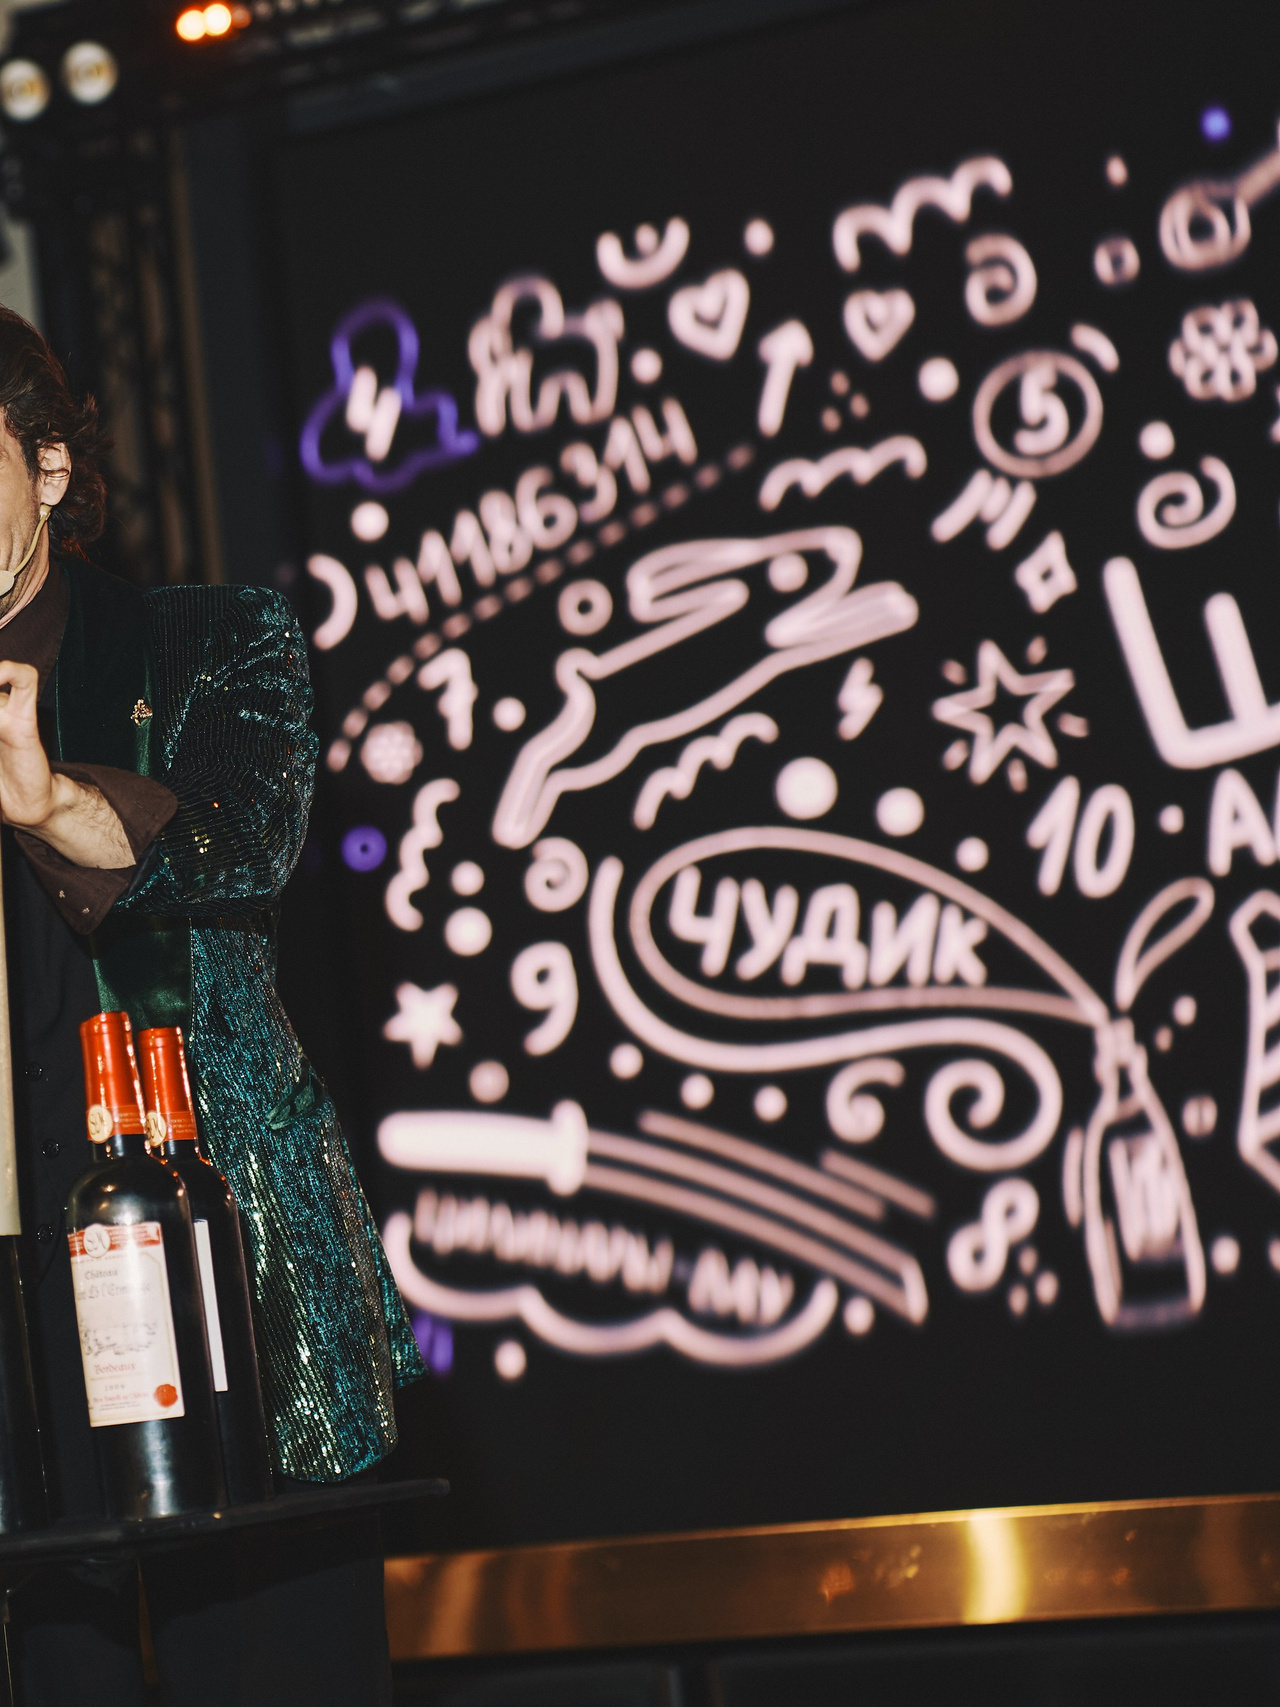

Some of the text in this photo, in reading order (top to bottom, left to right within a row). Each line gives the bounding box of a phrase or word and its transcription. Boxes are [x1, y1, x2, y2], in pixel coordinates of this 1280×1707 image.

[1026, 768, 1280, 898] 10 А
[669, 864, 988, 990] ЧУДИК
[510, 941, 578, 1056] 9
[947, 1177, 1039, 1292] 8
